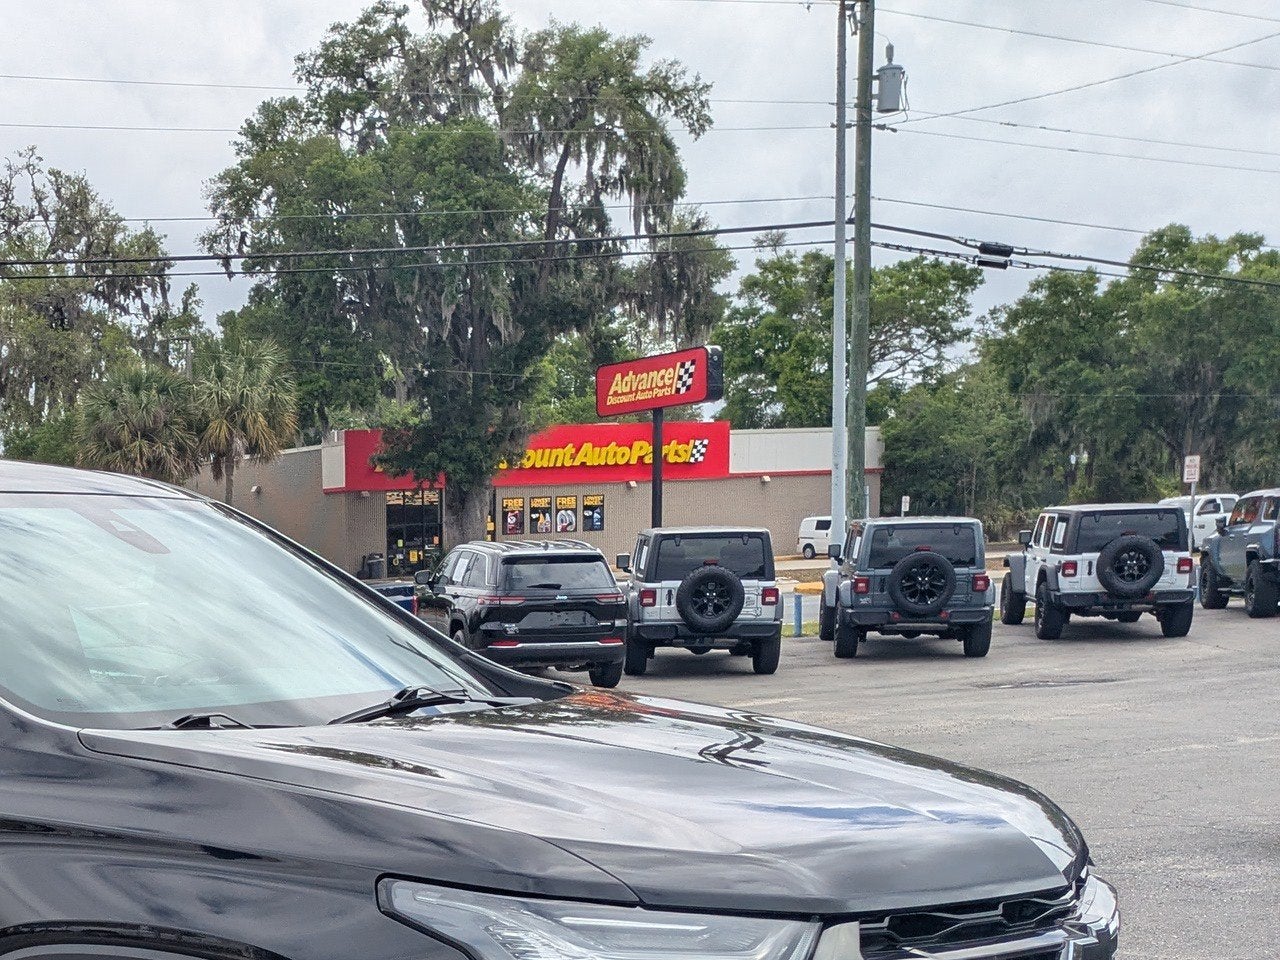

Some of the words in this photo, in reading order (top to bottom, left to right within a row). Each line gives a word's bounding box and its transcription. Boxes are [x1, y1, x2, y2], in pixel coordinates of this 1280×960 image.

[609, 367, 674, 395] Advance
[606, 392, 636, 405] Discount
[636, 389, 653, 401] Auto
[652, 385, 672, 398] Parts
[503, 499, 524, 508] FREE
[557, 496, 576, 505] FREE
